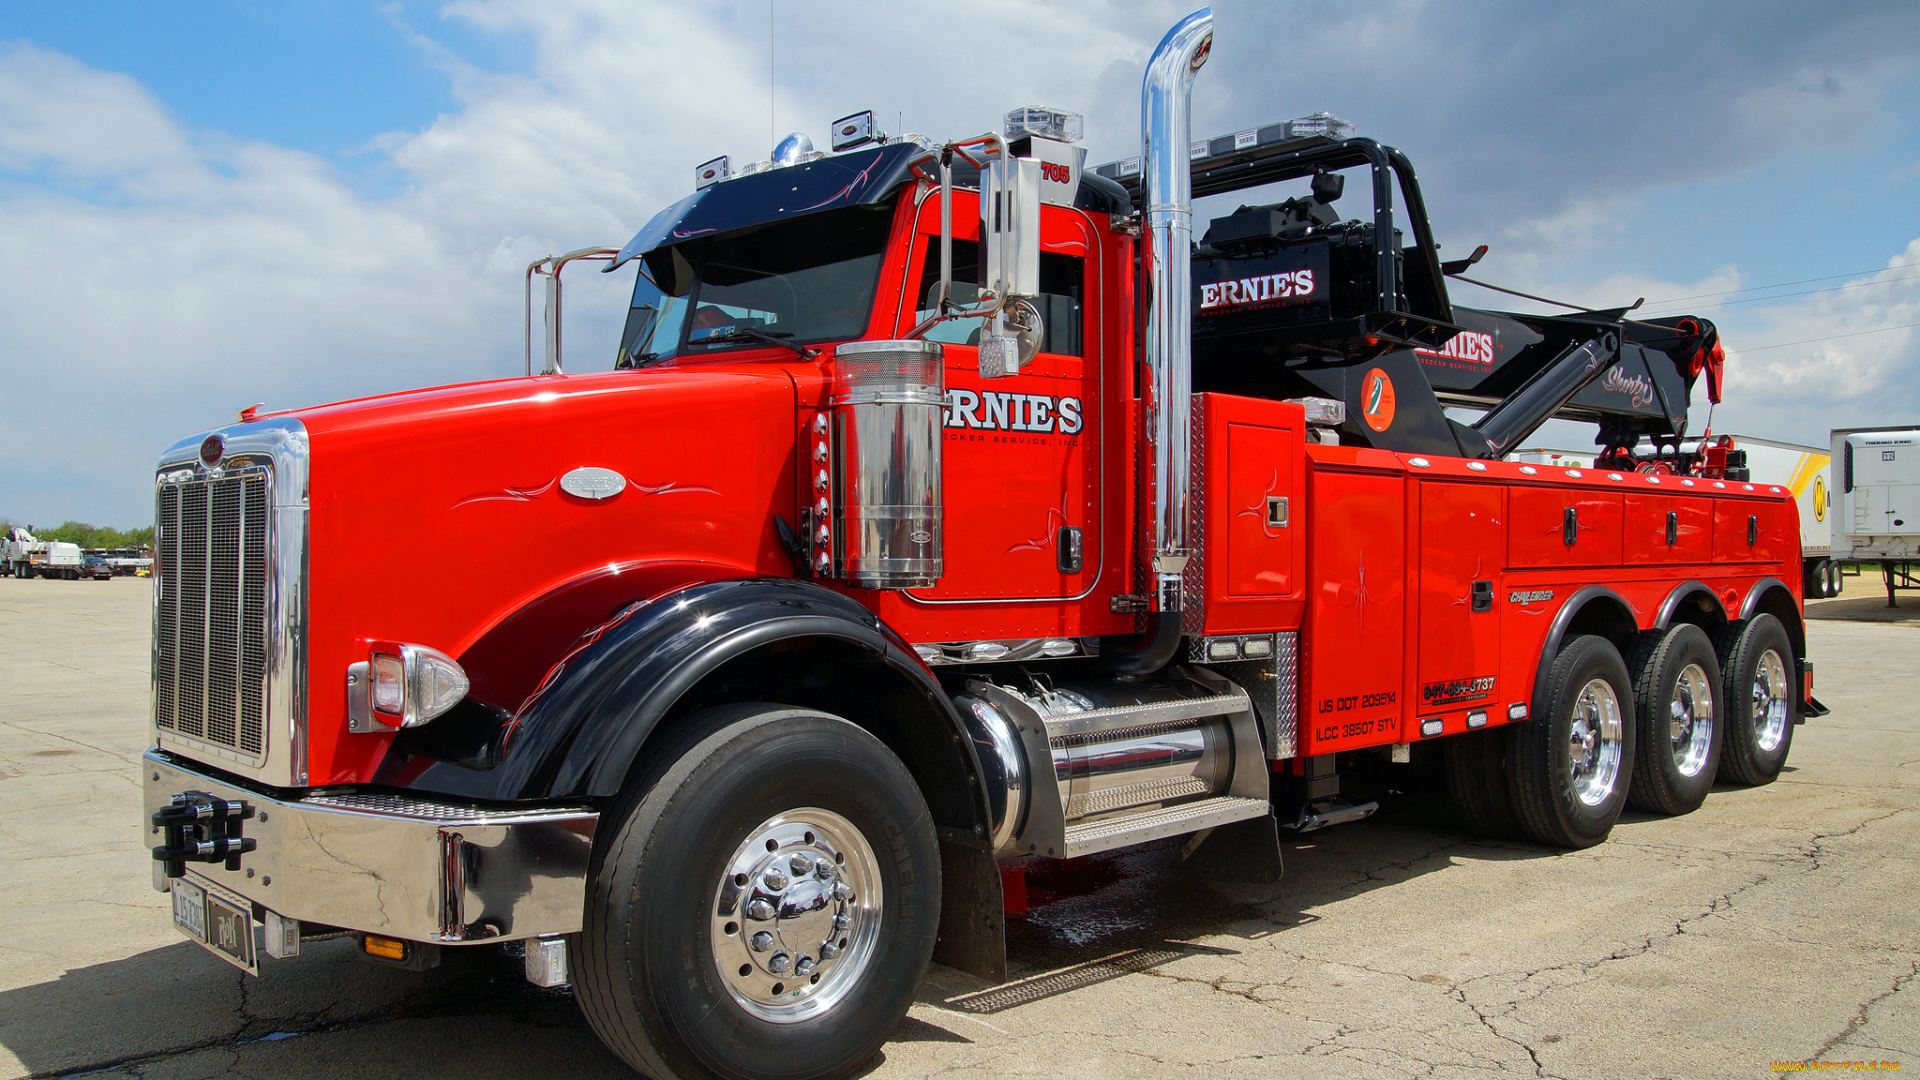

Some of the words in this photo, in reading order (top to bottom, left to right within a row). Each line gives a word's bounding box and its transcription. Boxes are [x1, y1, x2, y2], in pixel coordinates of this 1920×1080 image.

[1041, 161, 1070, 184] 705
[1200, 269, 1316, 309] ERNIE'S
[1414, 330, 1495, 365] NIE'S
[944, 387, 1084, 436] RNIE'S
[944, 433, 985, 442] ECKER
[1319, 699, 1333, 714] US
[1337, 696, 1358, 711] DOT
[1362, 691, 1396, 708] 209514
[1316, 726, 1338, 742] ILCC
[1342, 720, 1374, 737] 38507
[1377, 717, 1397, 732] STV
